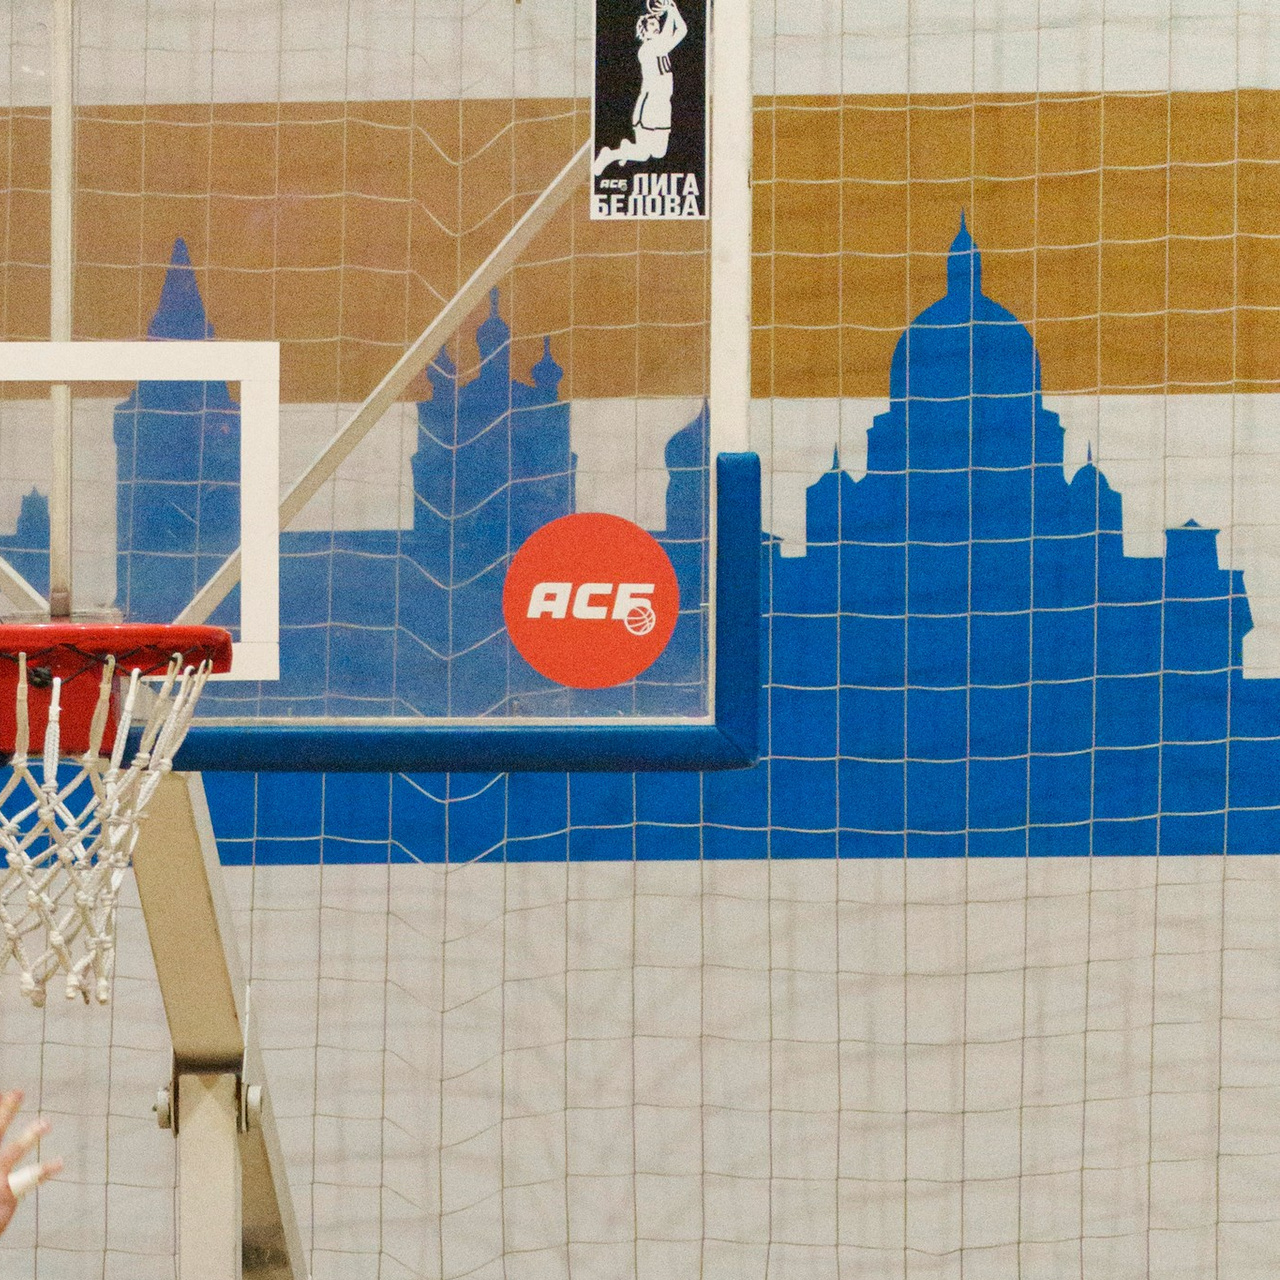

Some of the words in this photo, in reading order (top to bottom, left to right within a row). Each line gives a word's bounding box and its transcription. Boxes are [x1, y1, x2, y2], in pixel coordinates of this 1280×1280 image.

[631, 172, 700, 196] ЛИГА
[594, 195, 701, 217] БЕЛОВА
[526, 582, 656, 620] АСБ
